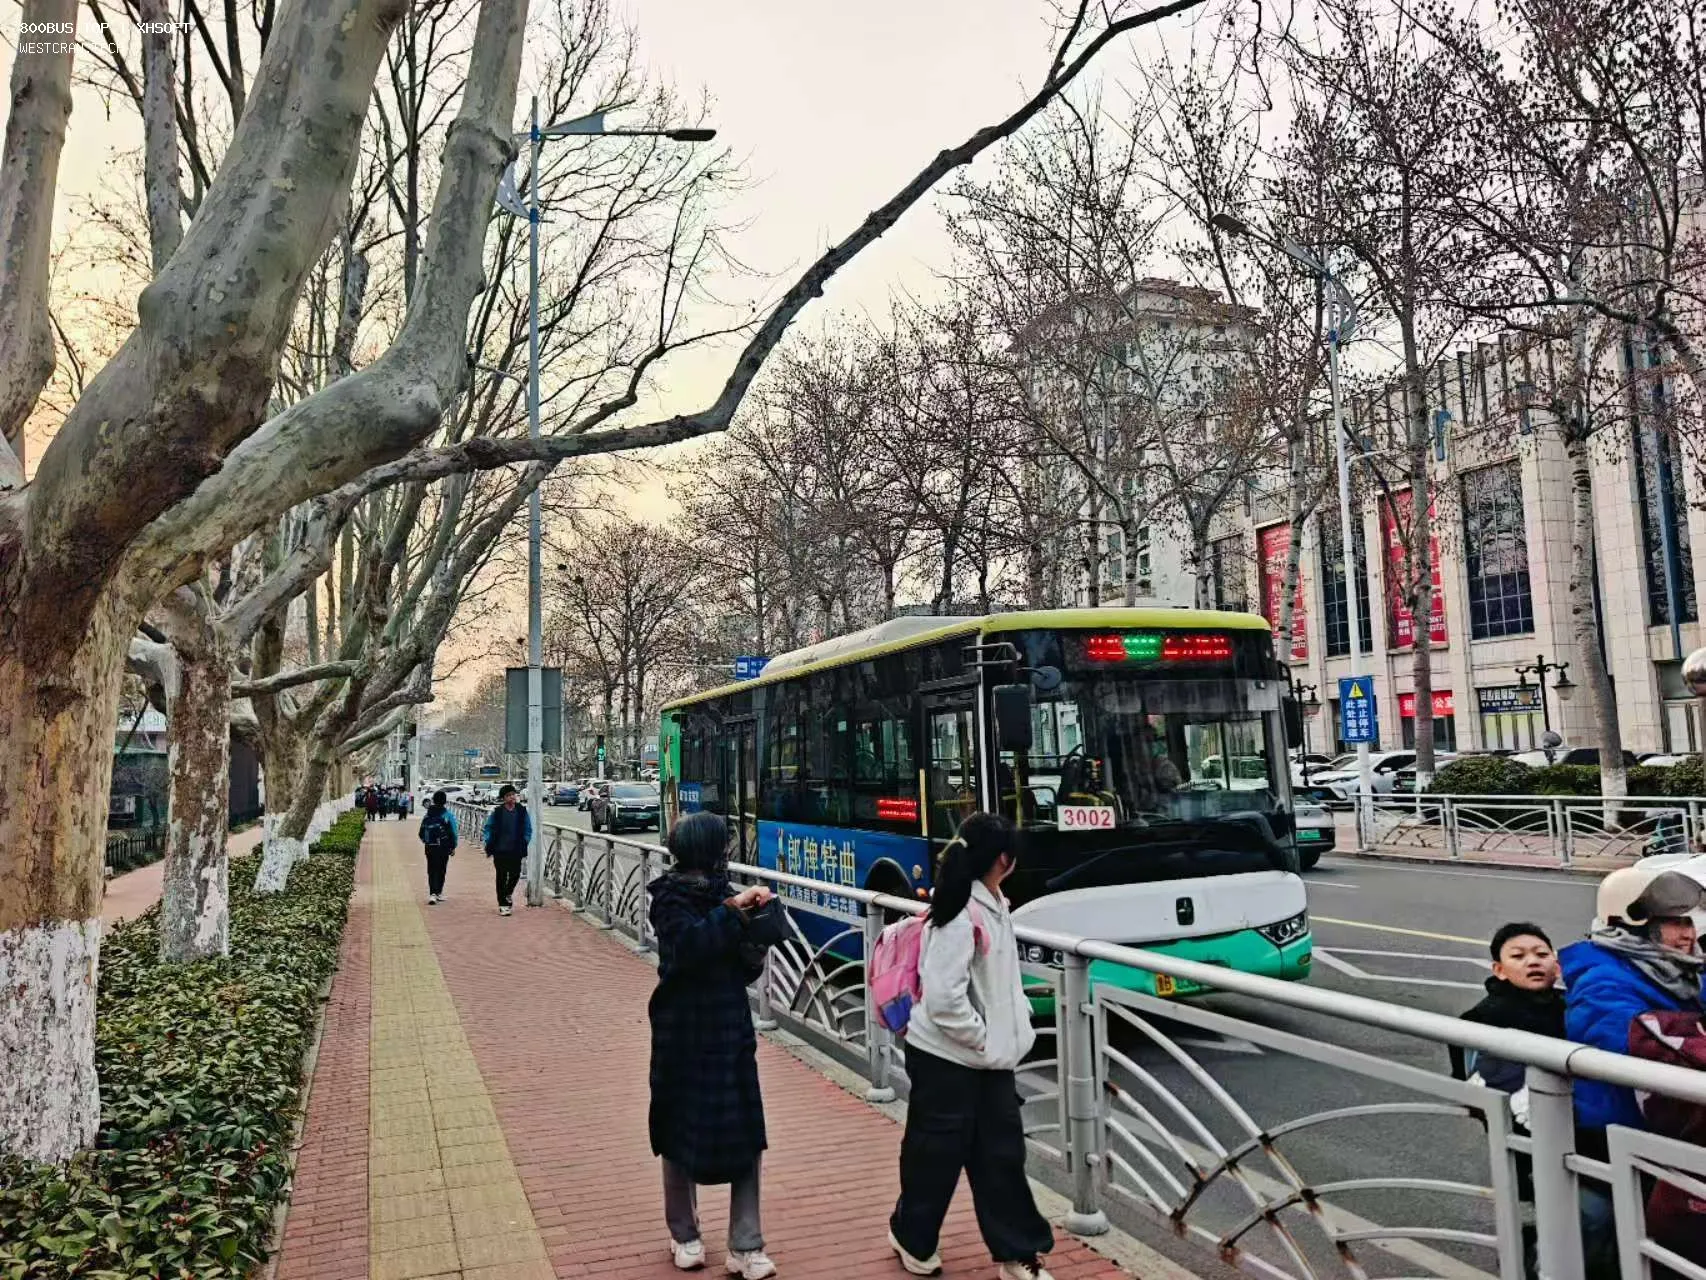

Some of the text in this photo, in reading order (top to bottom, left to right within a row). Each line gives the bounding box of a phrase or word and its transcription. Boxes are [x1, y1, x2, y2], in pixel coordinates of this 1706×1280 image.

[1357, 699, 1370, 738] 禁止停车
[1064, 809, 1111, 826] 3002
[788, 833, 856, 888] 郎牌特曲
